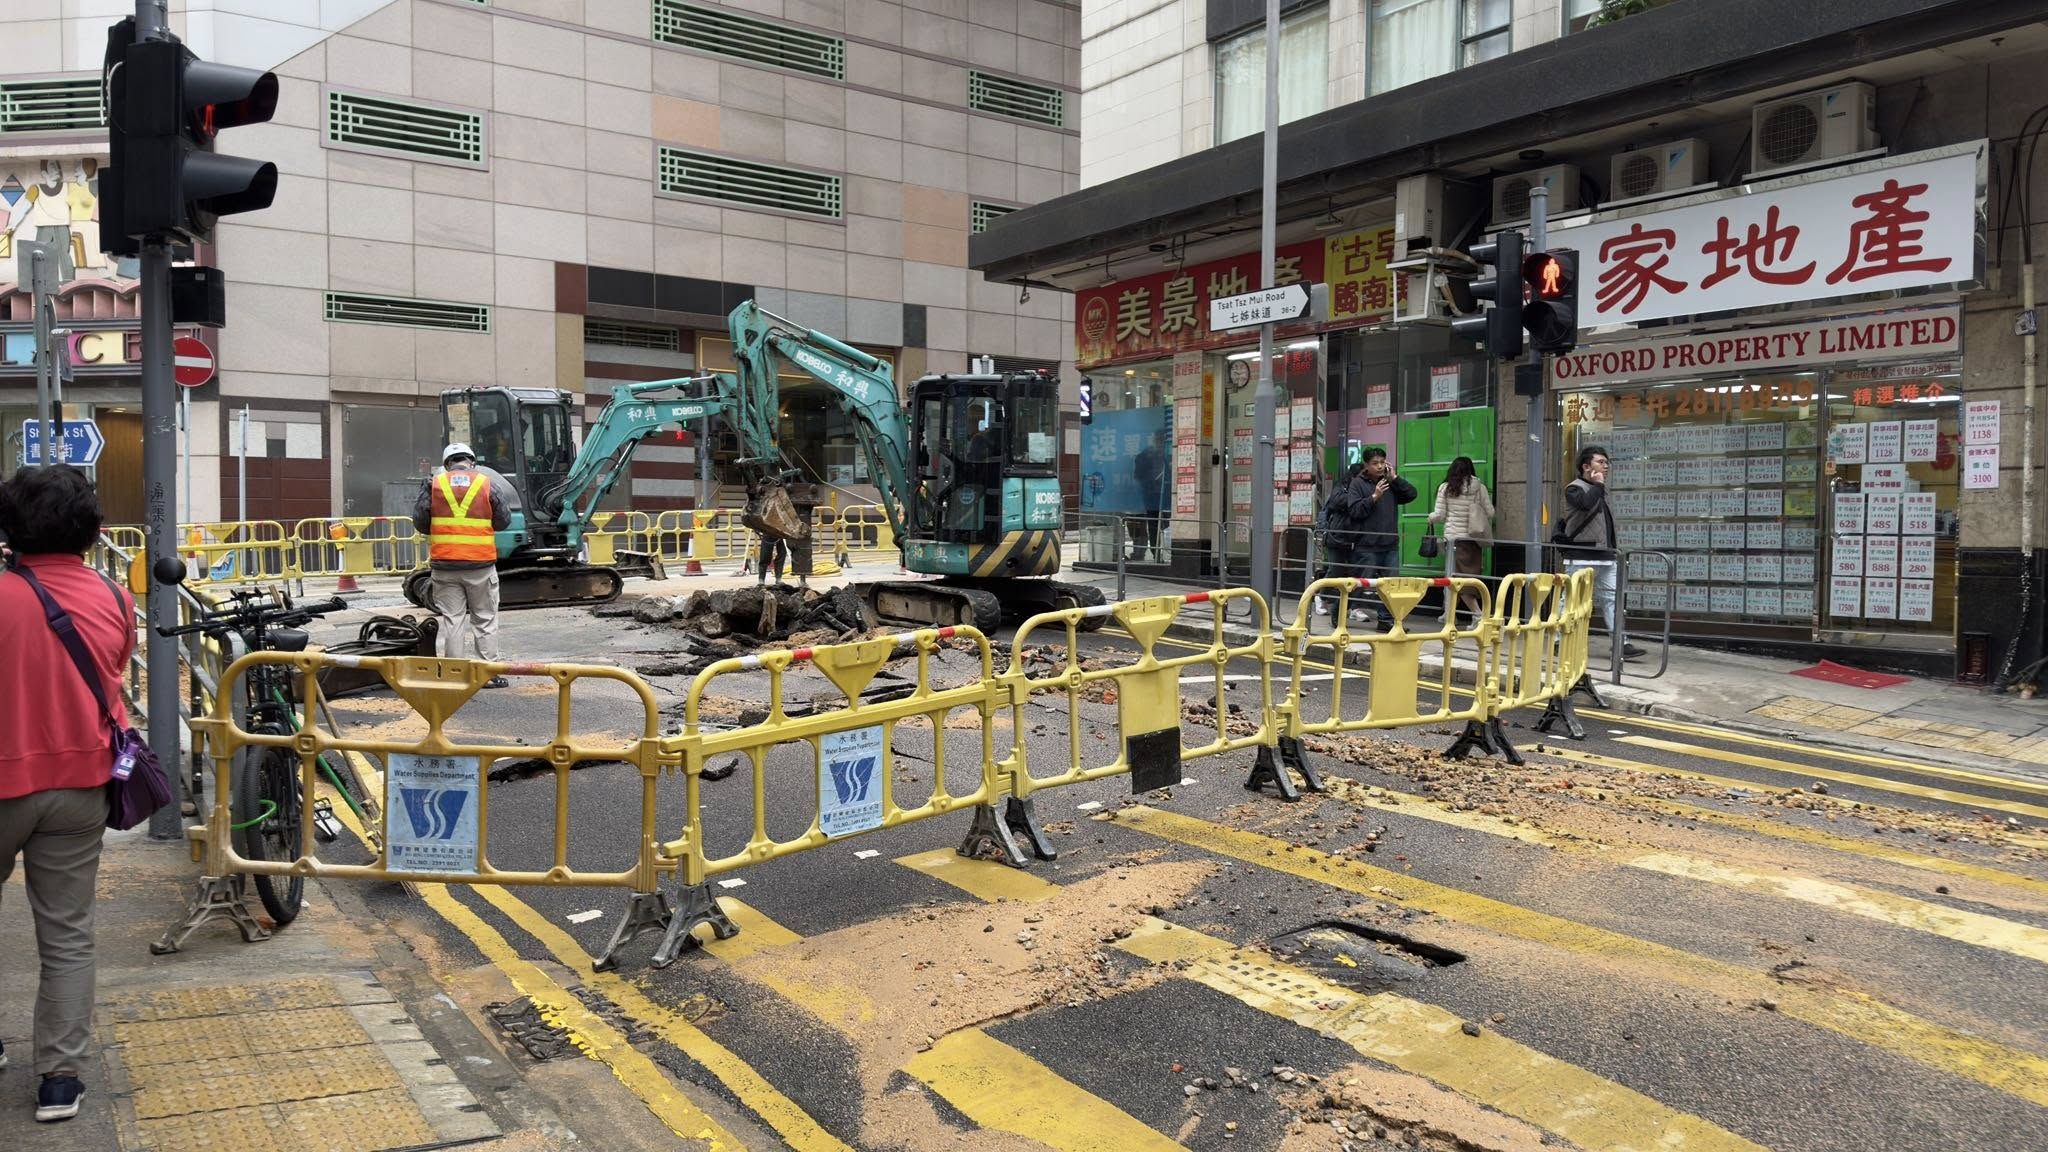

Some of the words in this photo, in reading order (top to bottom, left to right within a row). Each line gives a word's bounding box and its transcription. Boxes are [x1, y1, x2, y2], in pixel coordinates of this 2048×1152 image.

[1524, 179, 1952, 314] 家地產
[1217, 302, 1233, 311] Tsat
[1235, 299, 1247, 308] Tsz
[1249, 295, 1264, 305] Mui
[1266, 291, 1286, 302] Road
[1555, 348, 1656, 379] OXFORD
[1663, 331, 1811, 369] PROPERTY
[1818, 316, 1956, 355] LIMITED
[796, 350, 832, 374] KOBELCO
[1852, 381, 1944, 406] 精選推介
[672, 406, 703, 416] KOBELCO
[50, 428, 69, 438] Kk
[72, 428, 84, 438] St
[1972, 430, 1992, 440] 1138
[1911, 448, 1929, 456] 928
[1973, 474, 1992, 483] 3100
[1839, 520, 1856, 528] 628
[1872, 520, 1891, 529] 485
[1910, 520, 1927, 529] 518
[1839, 562, 1855, 571] 580
[1872, 564, 1890, 572] 888
[1909, 564, 1926, 573] 280
[413, 759, 456, 769] 水務署
[394, 769, 412, 777] Water
[413, 770, 439, 779] Supplies
[440, 771, 475, 780] Department
